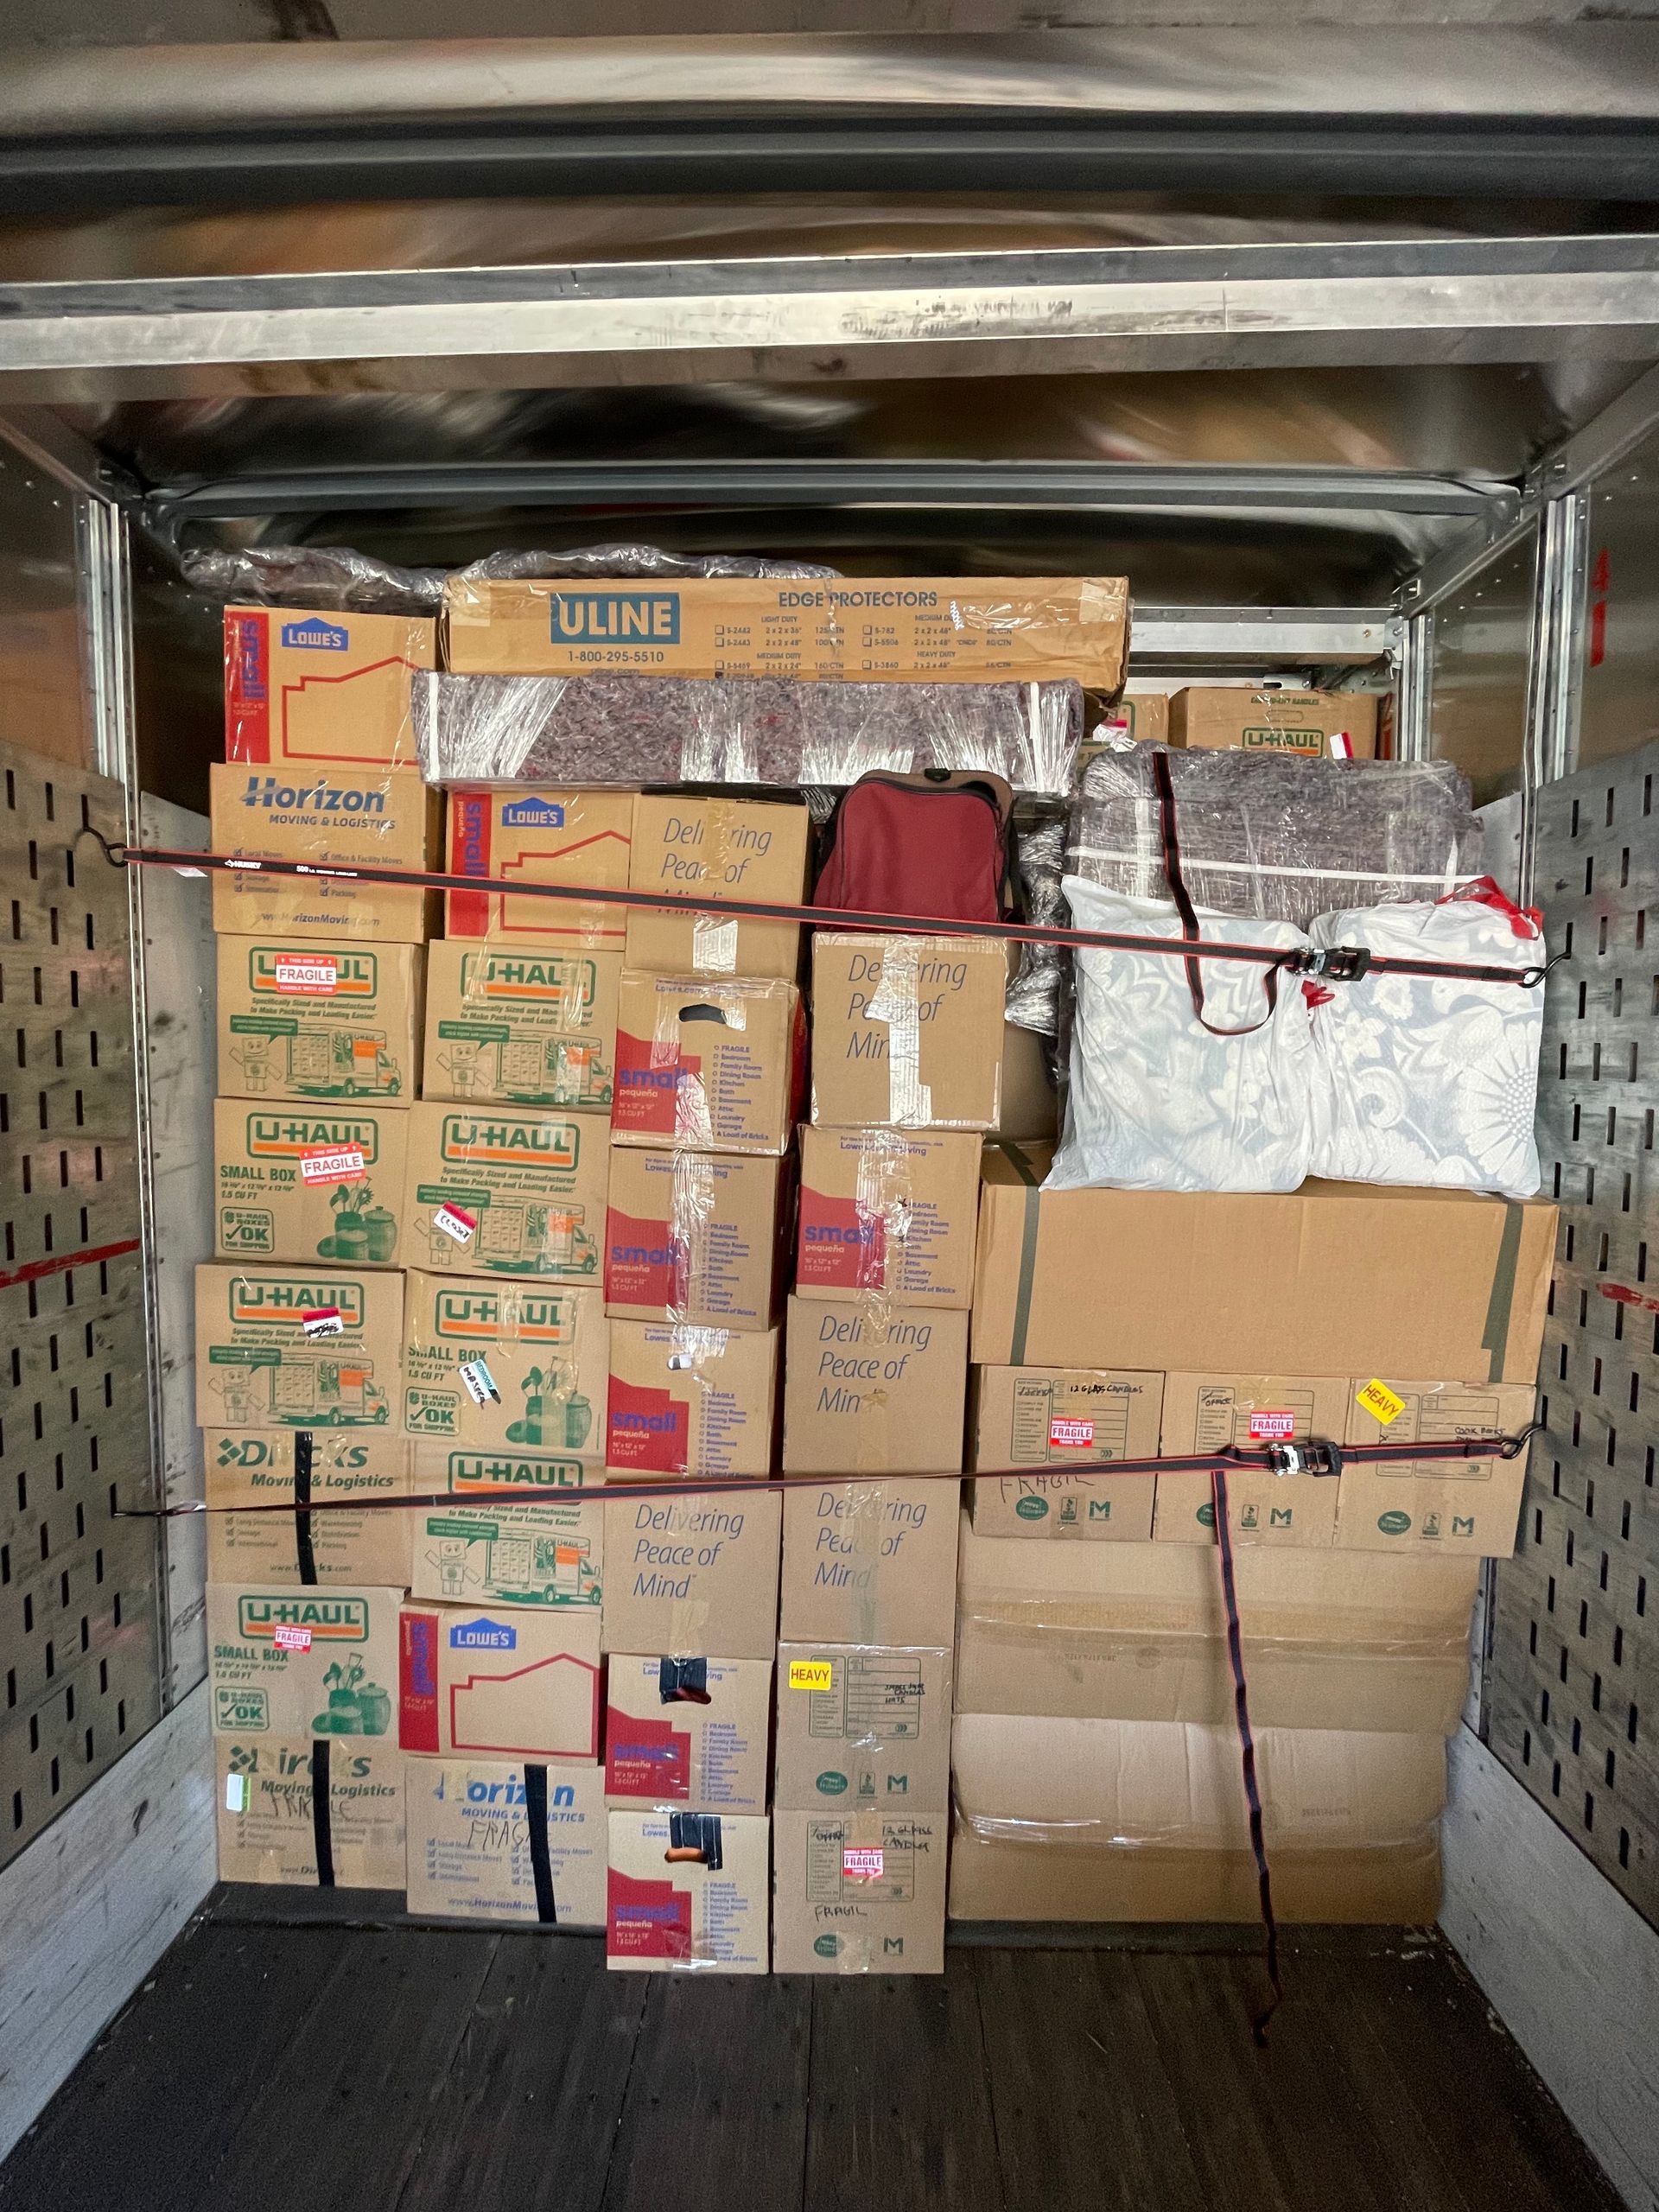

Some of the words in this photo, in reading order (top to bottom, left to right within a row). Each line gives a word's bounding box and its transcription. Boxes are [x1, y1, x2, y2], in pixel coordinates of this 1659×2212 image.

[779, 592, 823, 607] EDGE
[830, 591, 938, 607] PROTECTORS
[559, 601, 671, 636] ULINE
[289, 629, 341, 647] LOWE'S
[568, 651, 664, 663] 1-800-295-5510
[1249, 732, 1319, 747] U-HAUL
[243, 777, 385, 812] Horizon
[270, 814, 317, 824] MOVING
[321, 817, 329, 825] &
[334, 817, 396, 830] LOGISTICS
[509, 809, 557, 824] LOWE'S
[465, 802, 486, 876] small
[663, 817, 772, 856] Deliring
[234, 861, 261, 869] HUSKY
[724, 858, 752, 883] of
[279, 969, 334, 982] FRAGILE
[849, 954, 968, 991] Dering
[918, 994, 944, 1022] of
[721, 1053, 751, 1062] Bedroom
[720, 1062, 741, 1071] Family
[720, 1071, 741, 1080] Dining
[717, 1114, 745, 1122] Laundry
[256, 1121, 370, 1146] U-HAUL
[452, 1123, 570, 1153] U-HAUL
[304, 1155, 361, 1173] FRAGILE
[220, 1166, 264, 1180] SMALL
[270, 1168, 296, 1182] BOX
[442, 1166, 484, 1178] Specifically
[524, 1173, 576, 1184] Manufactured
[240, 1227, 269, 1242] OK
[805, 1244, 844, 1254] pequeña
[904, 1268, 931, 1276] Laundry
[238, 1286, 355, 1310] U-HAUL
[445, 1298, 564, 1326] U-HUL
[819, 1315, 932, 1351] Deliring
[458, 1348, 487, 1363] BOX
[818, 1351, 880, 1379] Peace
[884, 1354, 911, 1379] of
[421, 1370, 432, 1380] CU
[434, 1372, 444, 1381] FT
[817, 1387, 873, 1414] Min
[1363, 1384, 1400, 1417] HEAVY
[425, 1408, 454, 1424] OK
[613, 1411, 677, 1433] small
[1052, 1427, 1091, 1438] FRAGILE
[1253, 1421, 1292, 1430] FRAGILE
[1455, 1427, 1478, 1435] COOK
[613, 1430, 650, 1439] pequeña
[458, 1459, 575, 1487] U-HAUL
[311, 1475, 321, 1485] &
[326, 1474, 394, 1491] Logistics
[817, 1492, 927, 1529] Dering
[1270, 1507, 1293, 1525] M
[880, 1530, 906, 1556] of
[633, 1539, 694, 1565] Peace
[698, 1541, 724, 1566] of
[633, 1573, 691, 1599] Mind
[247, 1602, 359, 1624] U-HAUL
[276, 1632, 309, 1644] FRAGILE
[457, 1630, 510, 1646] LOWE'S
[214, 1645, 258, 1660] SMALL
[263, 1649, 289, 1662] BOX
[791, 1668, 830, 1682] HEAVY
[235, 1706, 263, 1719] OK
[332, 1783, 396, 1799] Logistics
[434, 1771, 575, 1807] orizn
[887, 1775, 907, 1792] M
[462, 1808, 508, 1819] MOVING
[512, 1809, 520, 1819] &
[845, 1856, 881, 1867] FRAGILE
[883, 1937, 904, 1956] M
